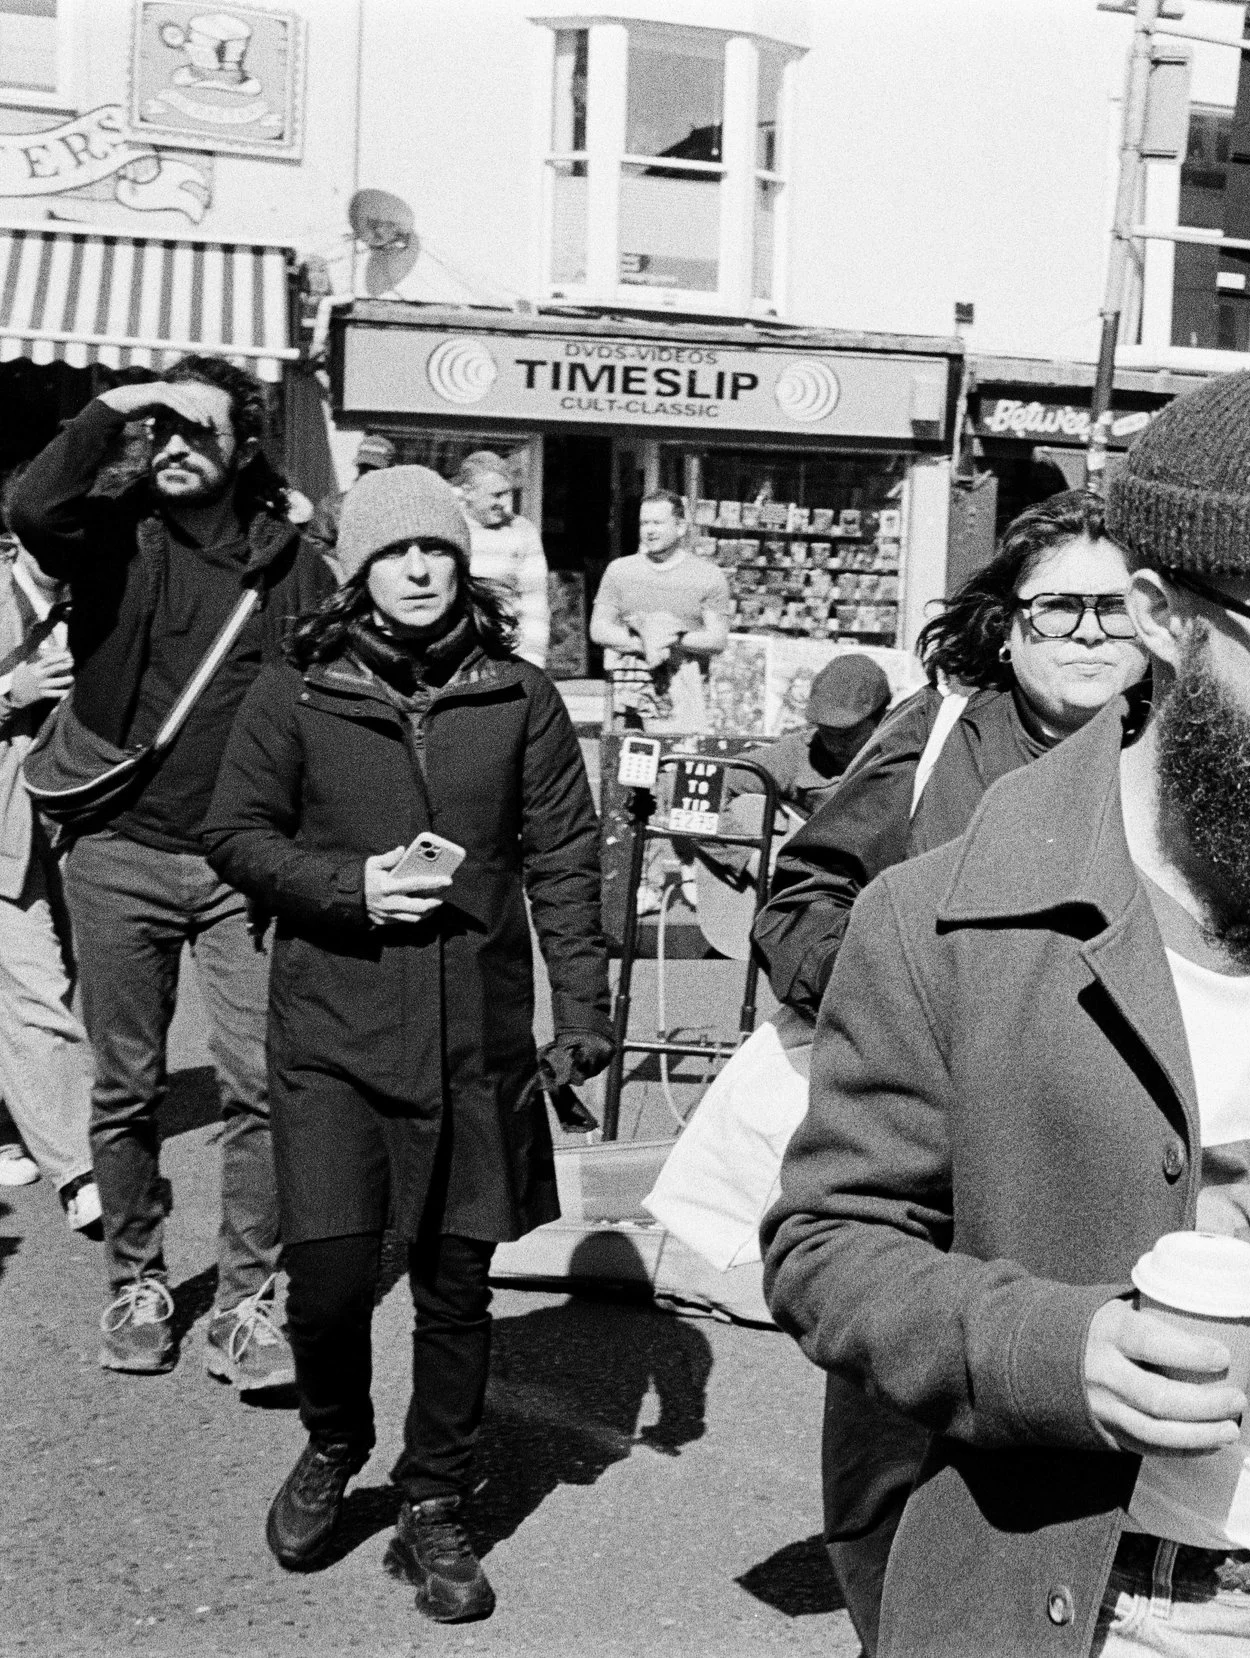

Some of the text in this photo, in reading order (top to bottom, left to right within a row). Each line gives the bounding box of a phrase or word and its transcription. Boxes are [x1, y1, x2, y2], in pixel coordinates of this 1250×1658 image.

[1, 114, 122, 178] ERS
[564, 342, 719, 366] DVDS-VIDEOS
[515, 358, 759, 401] TIMESLIP
[560, 396, 719, 418] CULT-CLASSIC
[984, 399, 1094, 440] Betwee
[685, 761, 717, 777] TAP
[688, 780, 709, 794] TO
[682, 797, 711, 812] TIP
